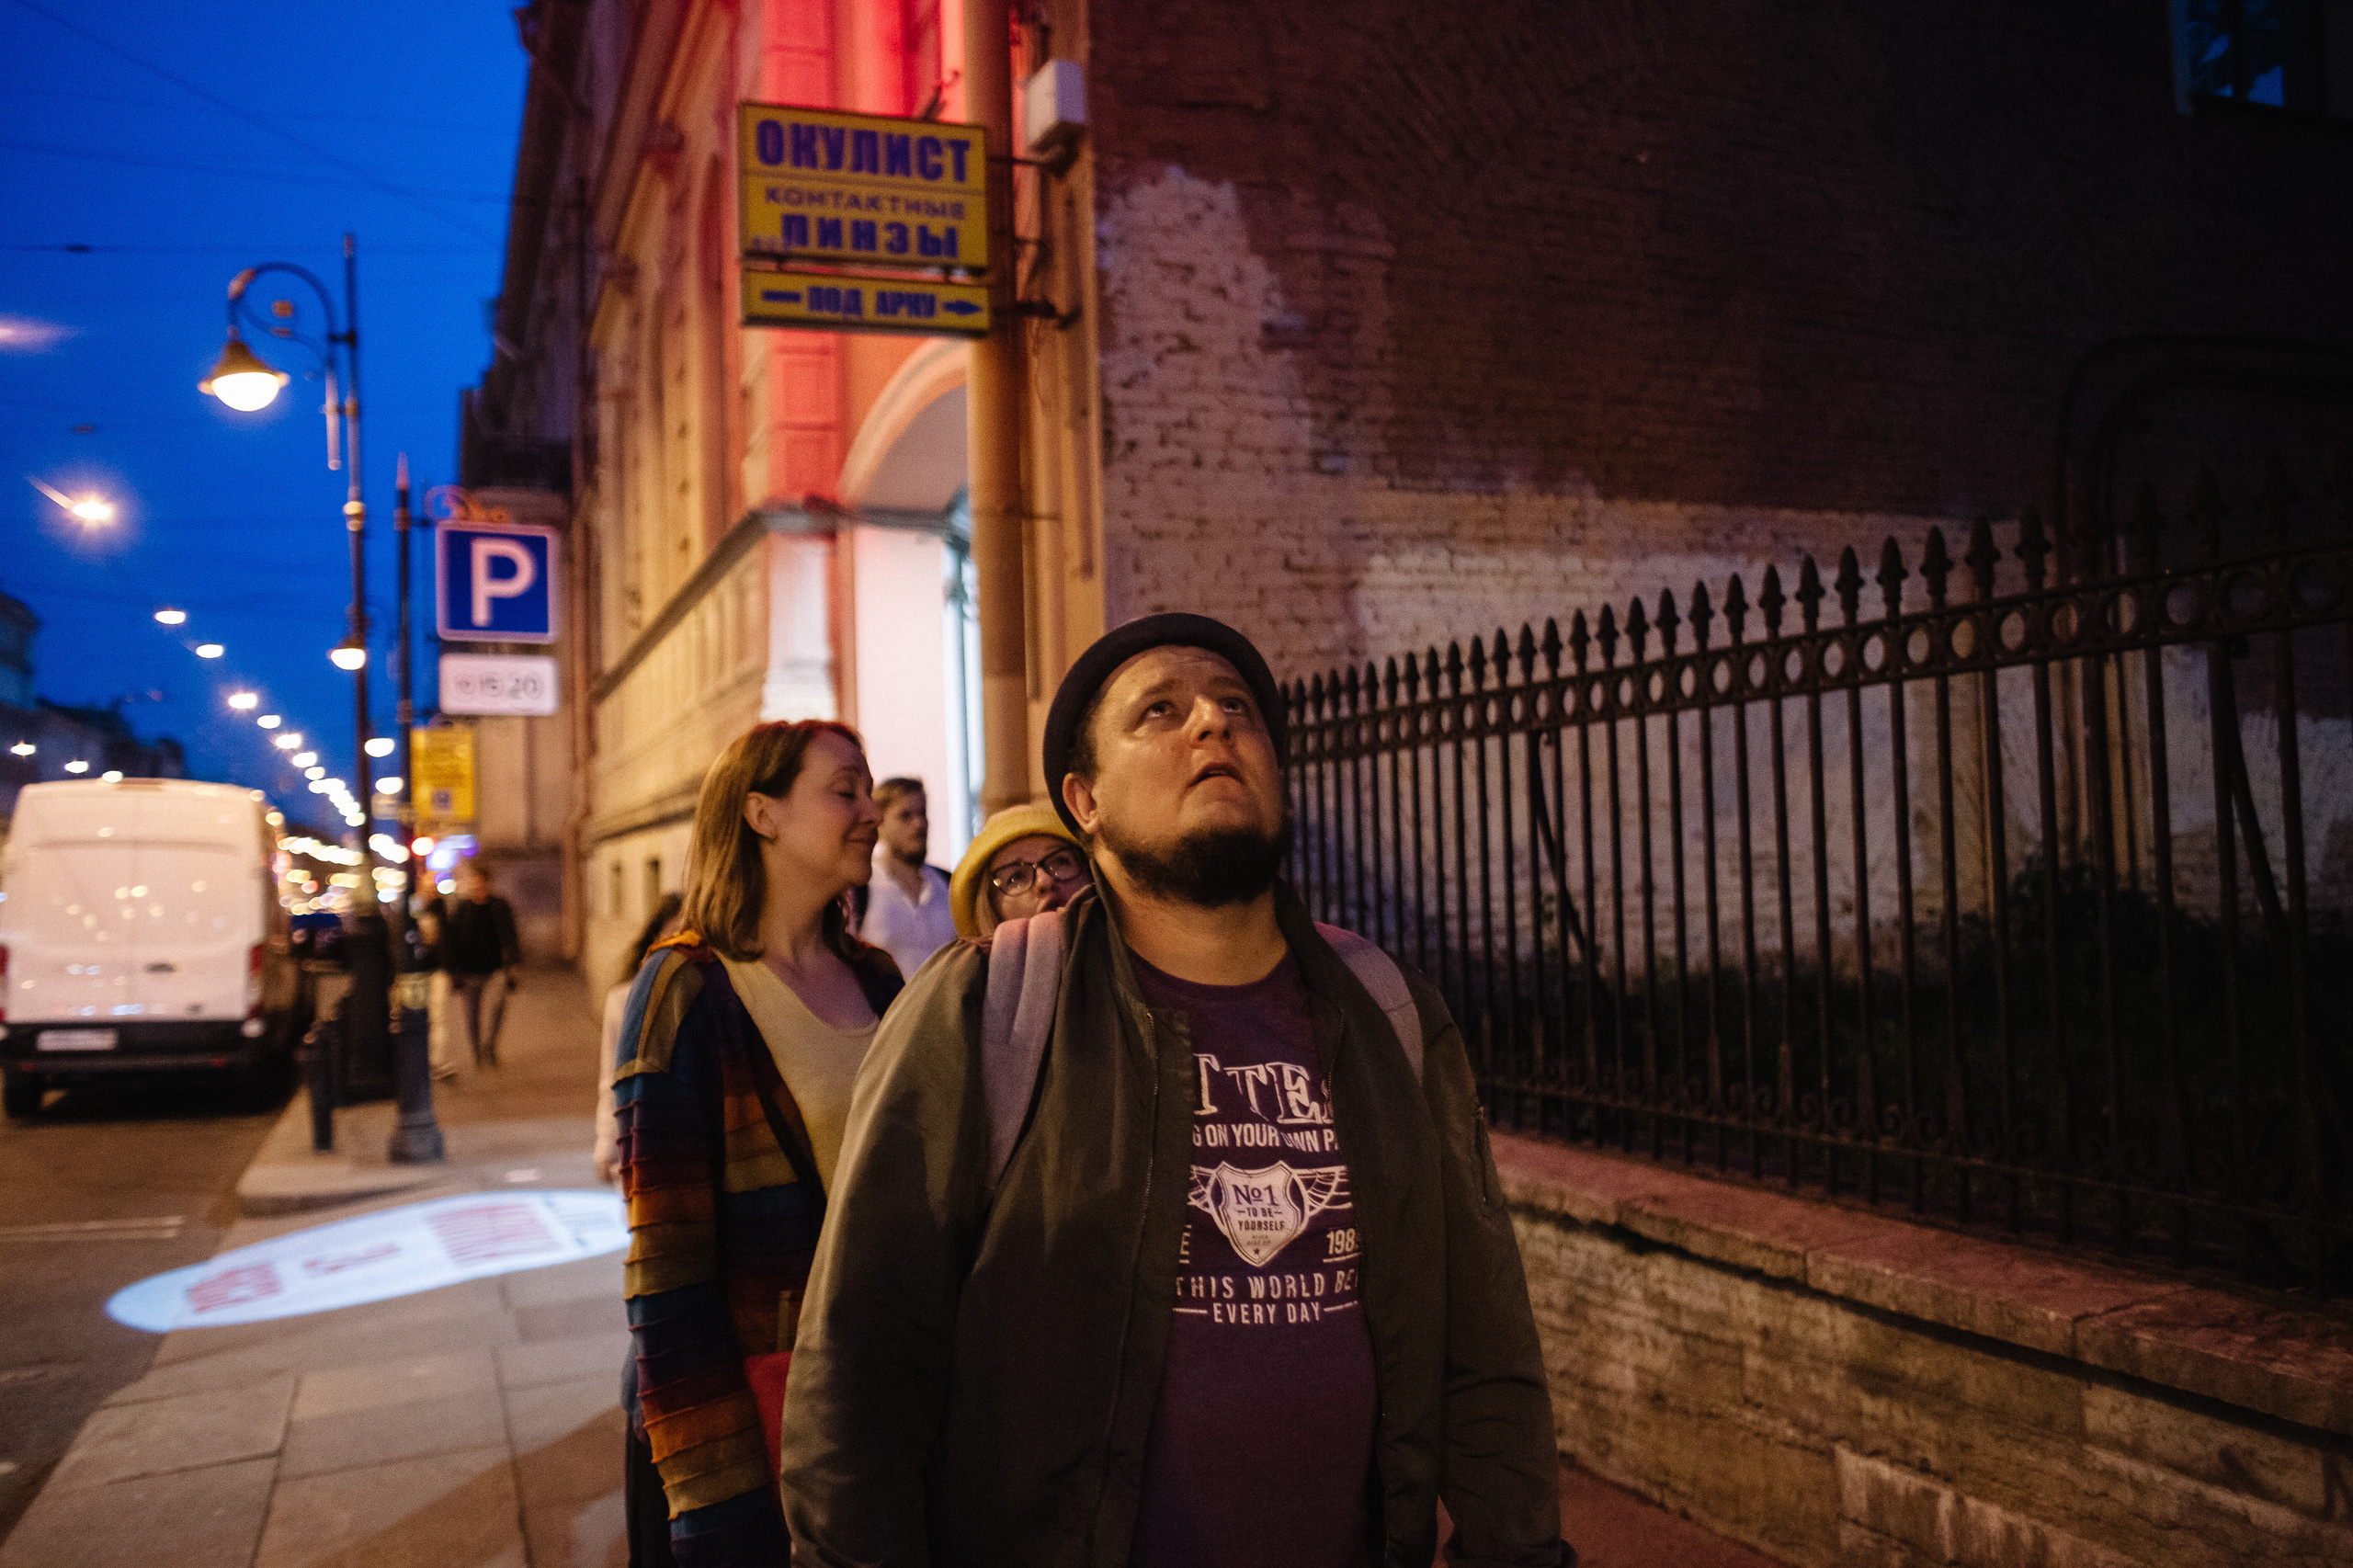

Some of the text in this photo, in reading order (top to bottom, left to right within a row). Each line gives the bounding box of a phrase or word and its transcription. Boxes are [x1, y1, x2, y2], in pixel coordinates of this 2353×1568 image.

[756, 119, 970, 182] ОКУЛИСТ
[765, 187, 965, 221] КОНТАКТНЫЕ
[781, 213, 958, 258] ЛИНЗЫ
[471, 537, 537, 627] P
[1205, 1123, 1229, 1147] ON
[1232, 1123, 1279, 1147] YOUR
[1323, 1129, 1338, 1151] P
[1237, 1220, 1285, 1232] YOURSELF
[1246, 1207, 1274, 1218] TO BE
[1325, 1228, 1358, 1255] 198
[1247, 1272, 1325, 1300] WORLD
[1334, 1268, 1358, 1293] BE
[1212, 1301, 1321, 1324] EVERY DAY
